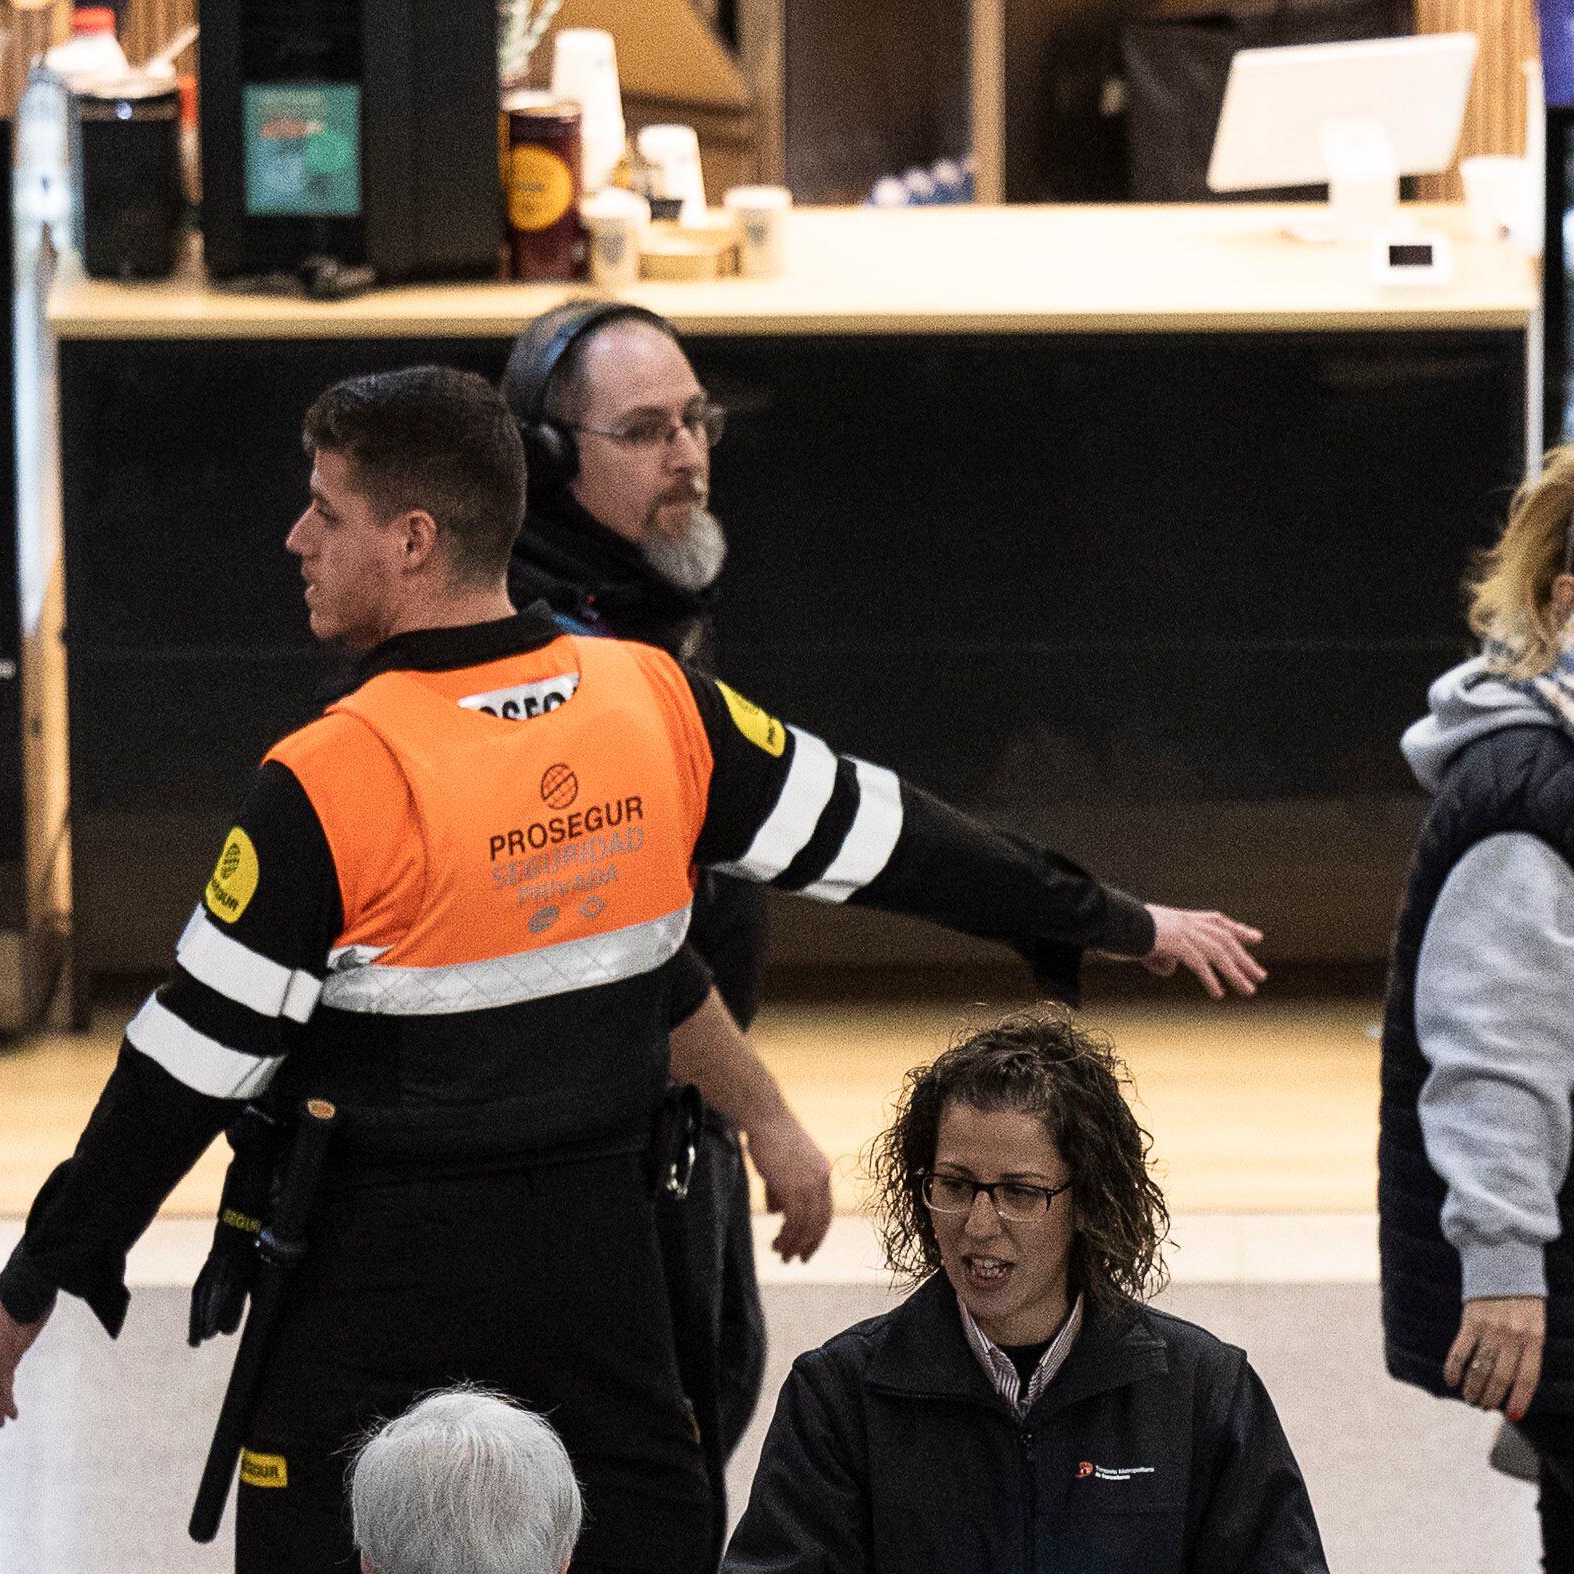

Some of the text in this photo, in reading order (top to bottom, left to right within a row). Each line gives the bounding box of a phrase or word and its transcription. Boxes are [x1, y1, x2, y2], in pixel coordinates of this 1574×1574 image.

[490, 796, 643, 861] PROSEGUR
[492, 826, 644, 890] SEGURIDAD
[517, 863, 619, 905] PRIVADA
